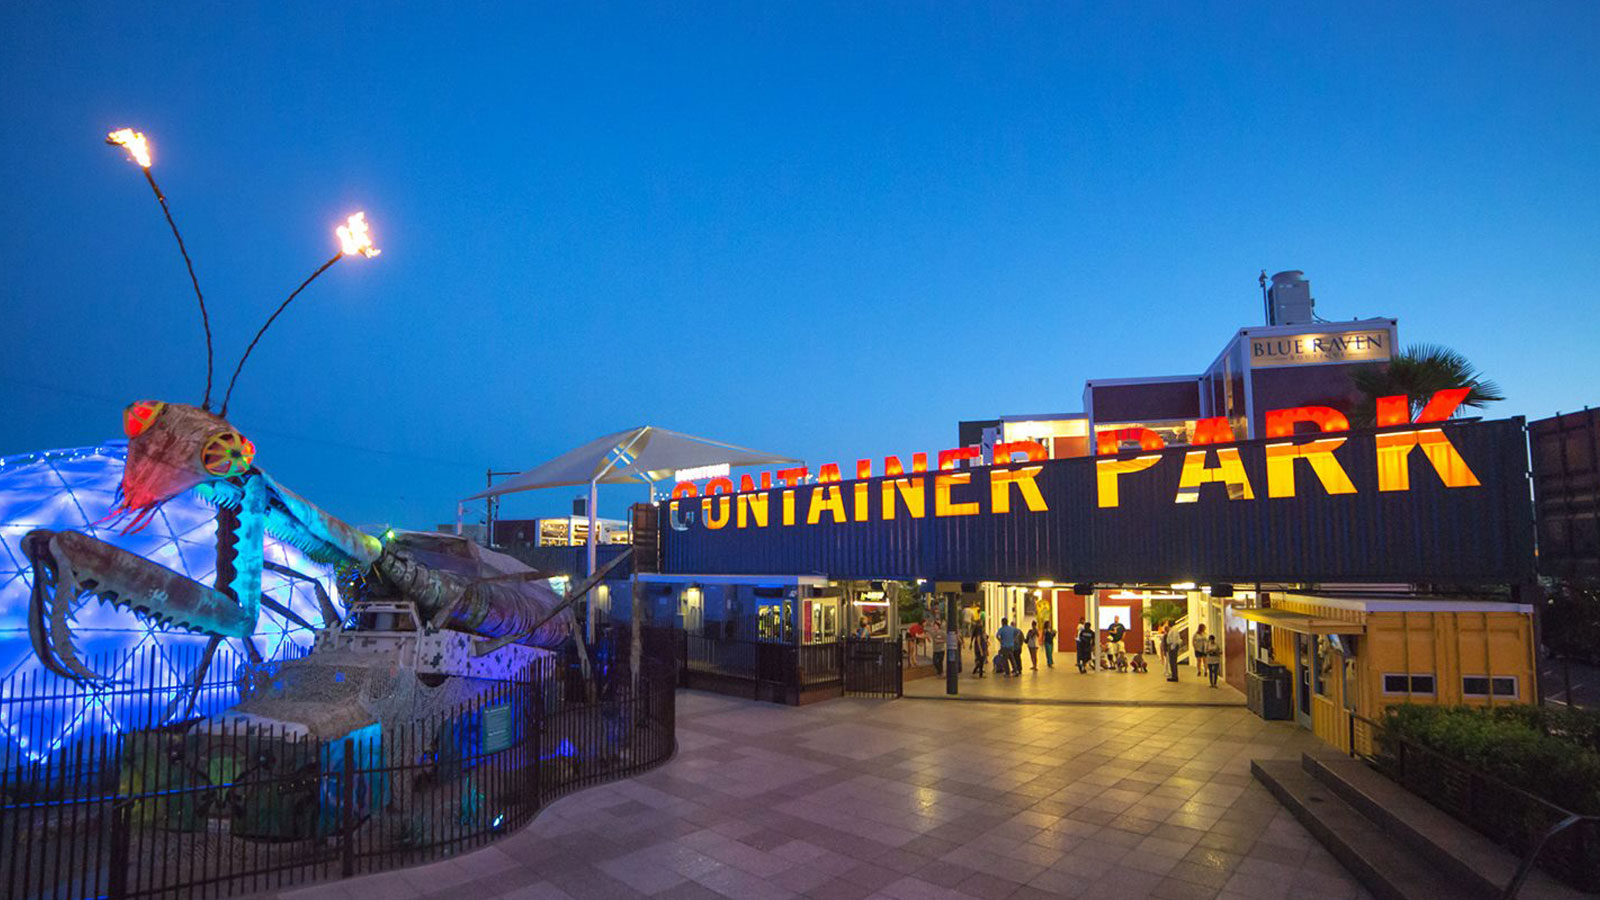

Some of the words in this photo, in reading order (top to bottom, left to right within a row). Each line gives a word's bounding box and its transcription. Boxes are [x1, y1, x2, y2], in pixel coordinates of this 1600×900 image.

[1254, 339, 1303, 357] BLUE
[1312, 334, 1383, 353] RAVEN
[669, 440, 1050, 531] CONTAINER
[1096, 387, 1482, 508] PARK
